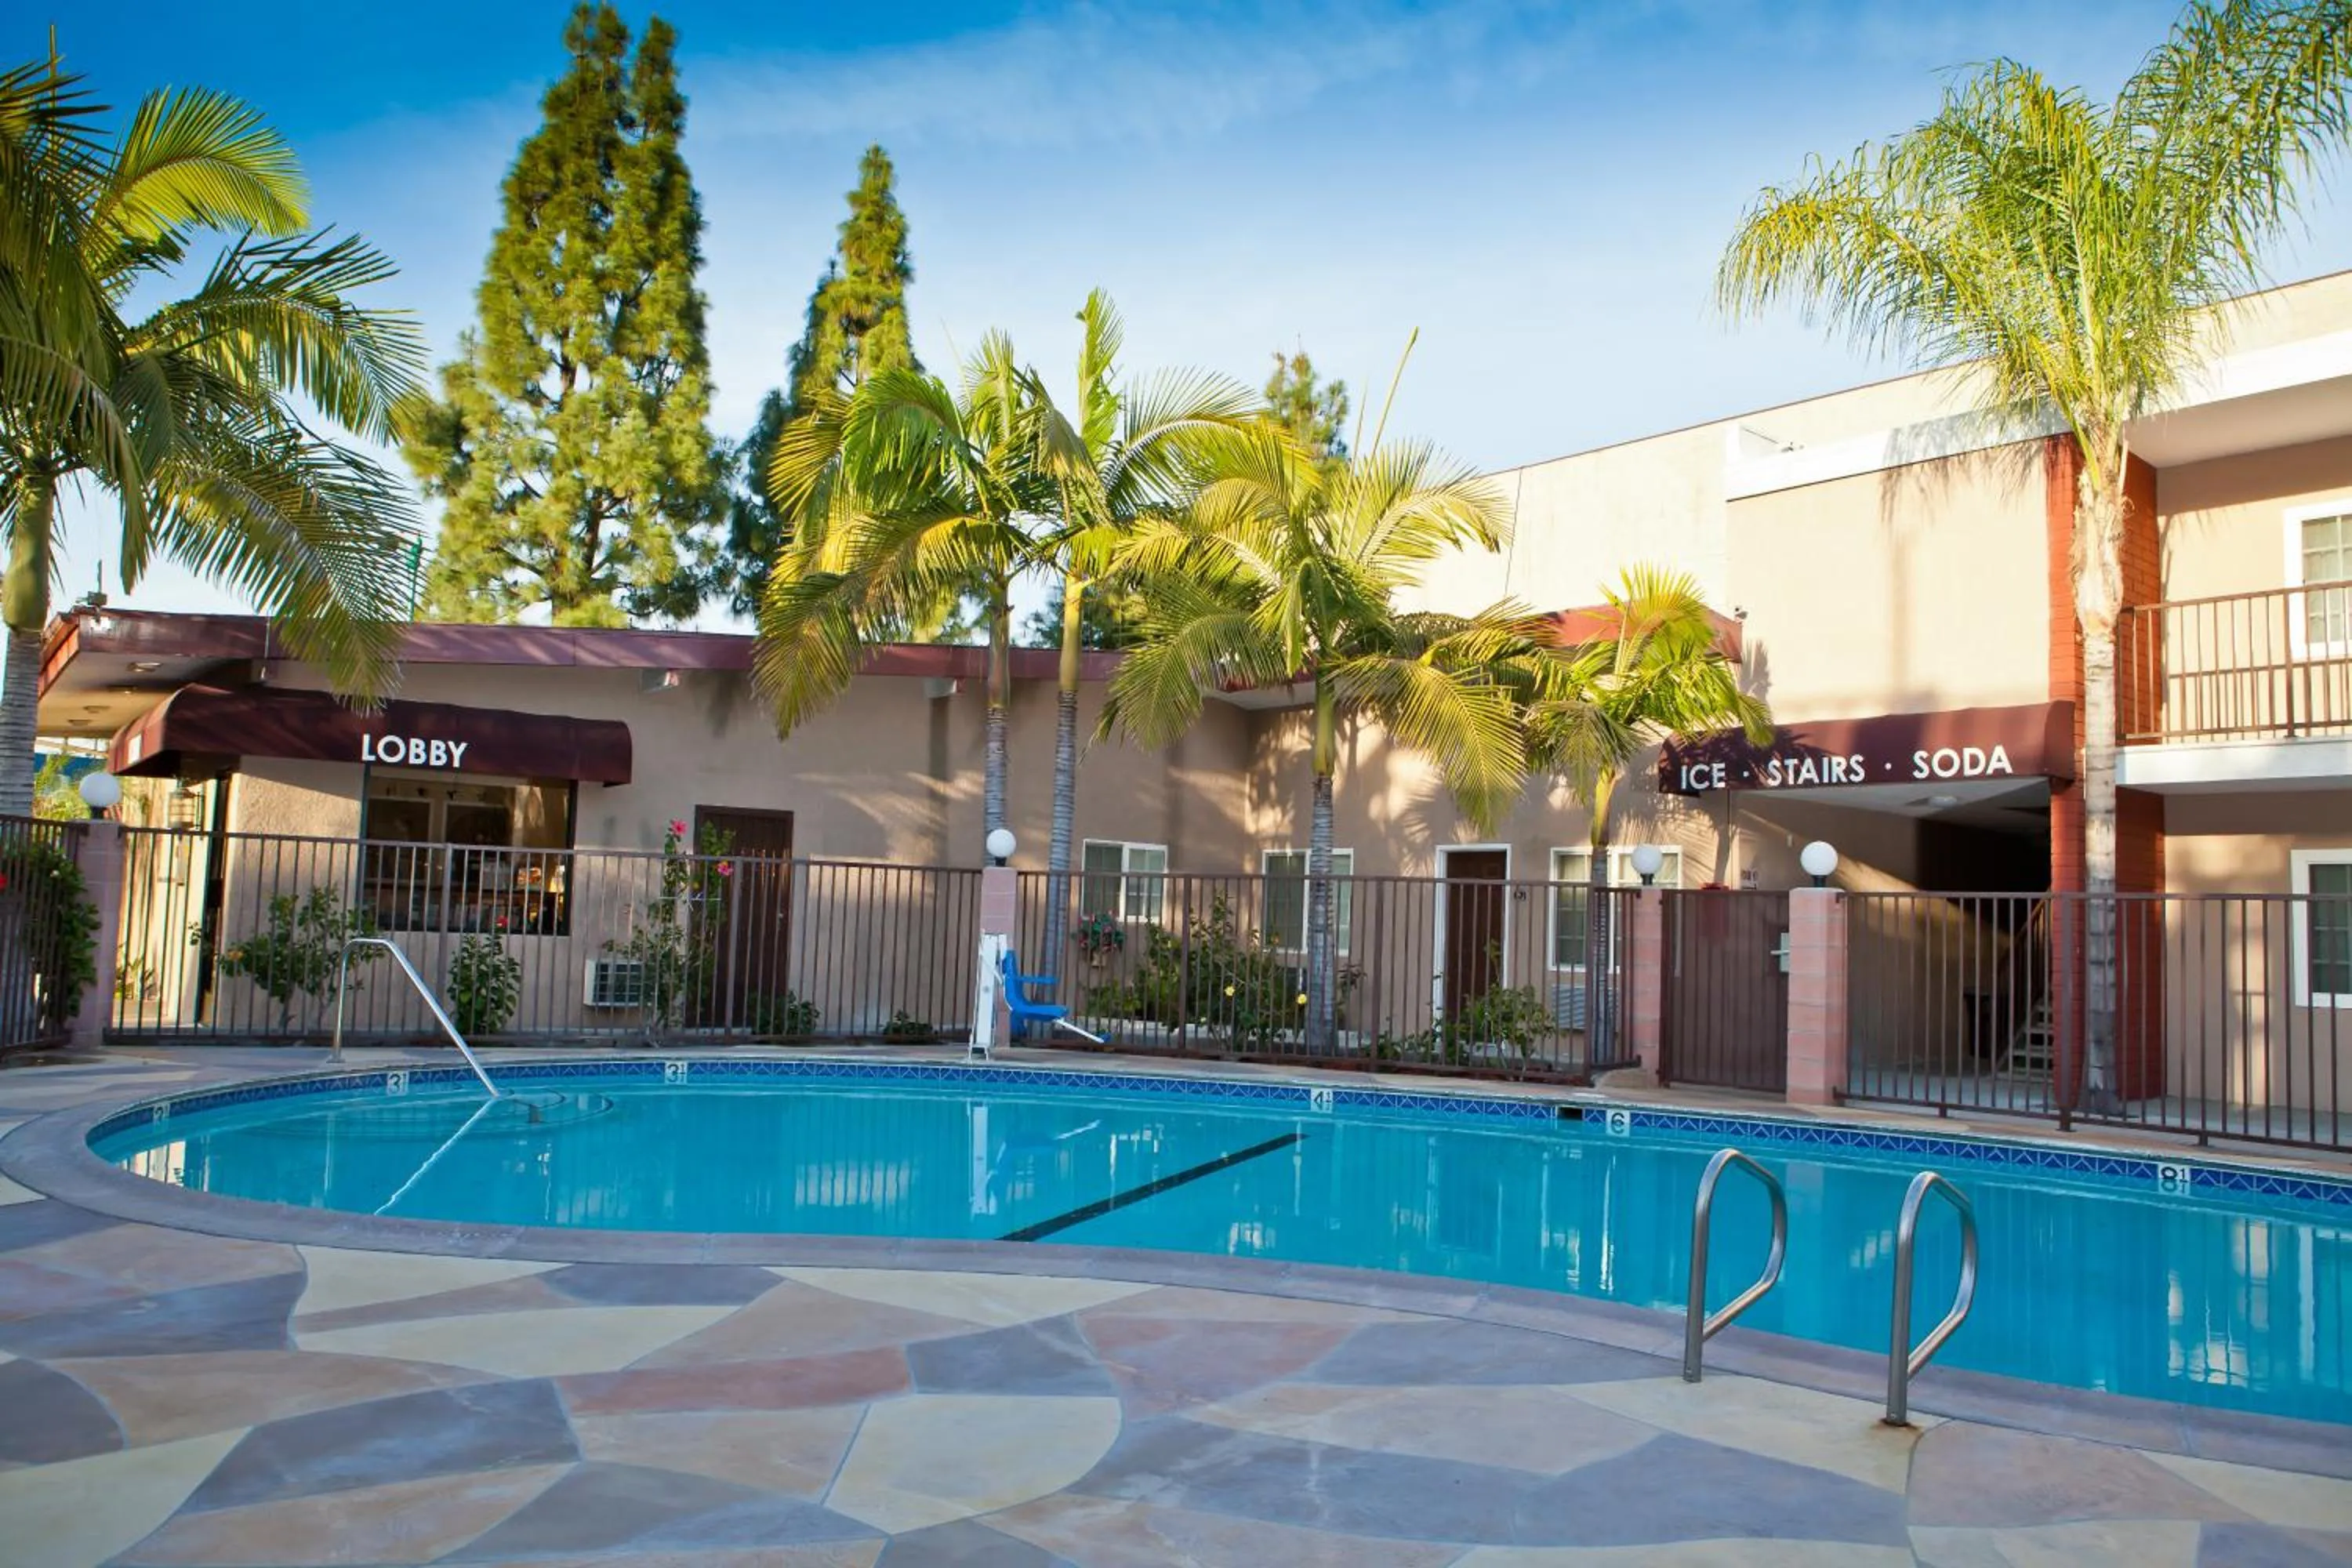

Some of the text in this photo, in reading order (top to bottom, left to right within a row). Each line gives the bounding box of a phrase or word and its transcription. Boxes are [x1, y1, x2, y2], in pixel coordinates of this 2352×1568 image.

[361, 733, 468, 768] LOBBY
[1680, 745, 2013, 790] ICE STAIRS SODA
